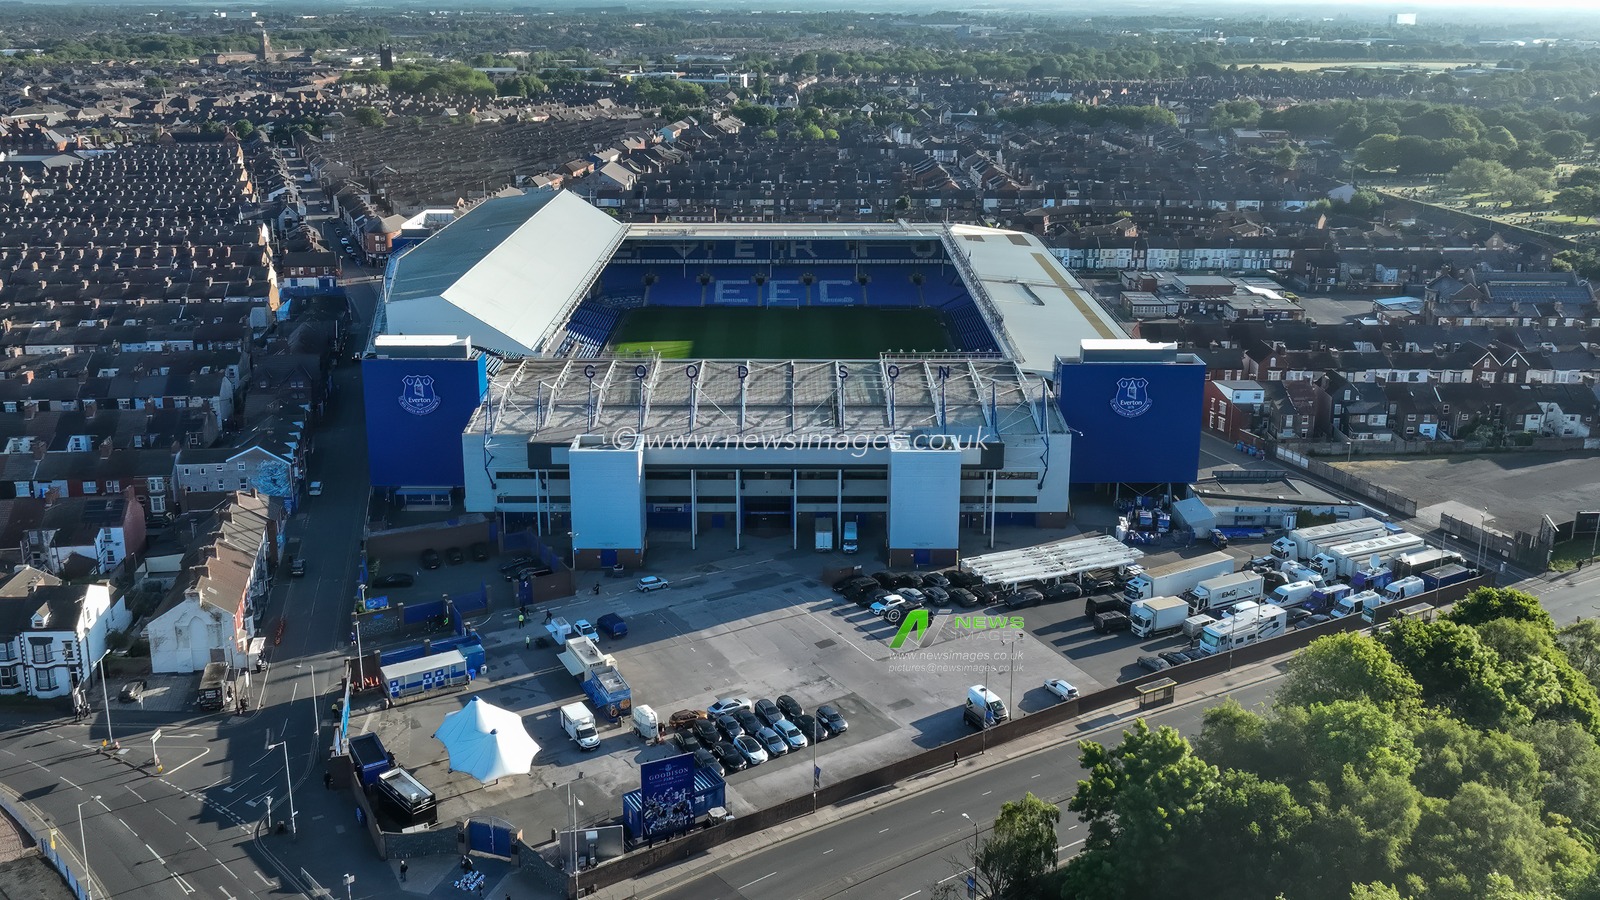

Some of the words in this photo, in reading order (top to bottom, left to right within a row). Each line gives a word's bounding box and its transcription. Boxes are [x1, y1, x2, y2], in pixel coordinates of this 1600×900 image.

[714, 280, 854, 302] EFC
[584, 365, 950, 379] GOODISON
[1221, 589, 1236, 598] EMG
[648, 767, 689, 781] GOODISON
